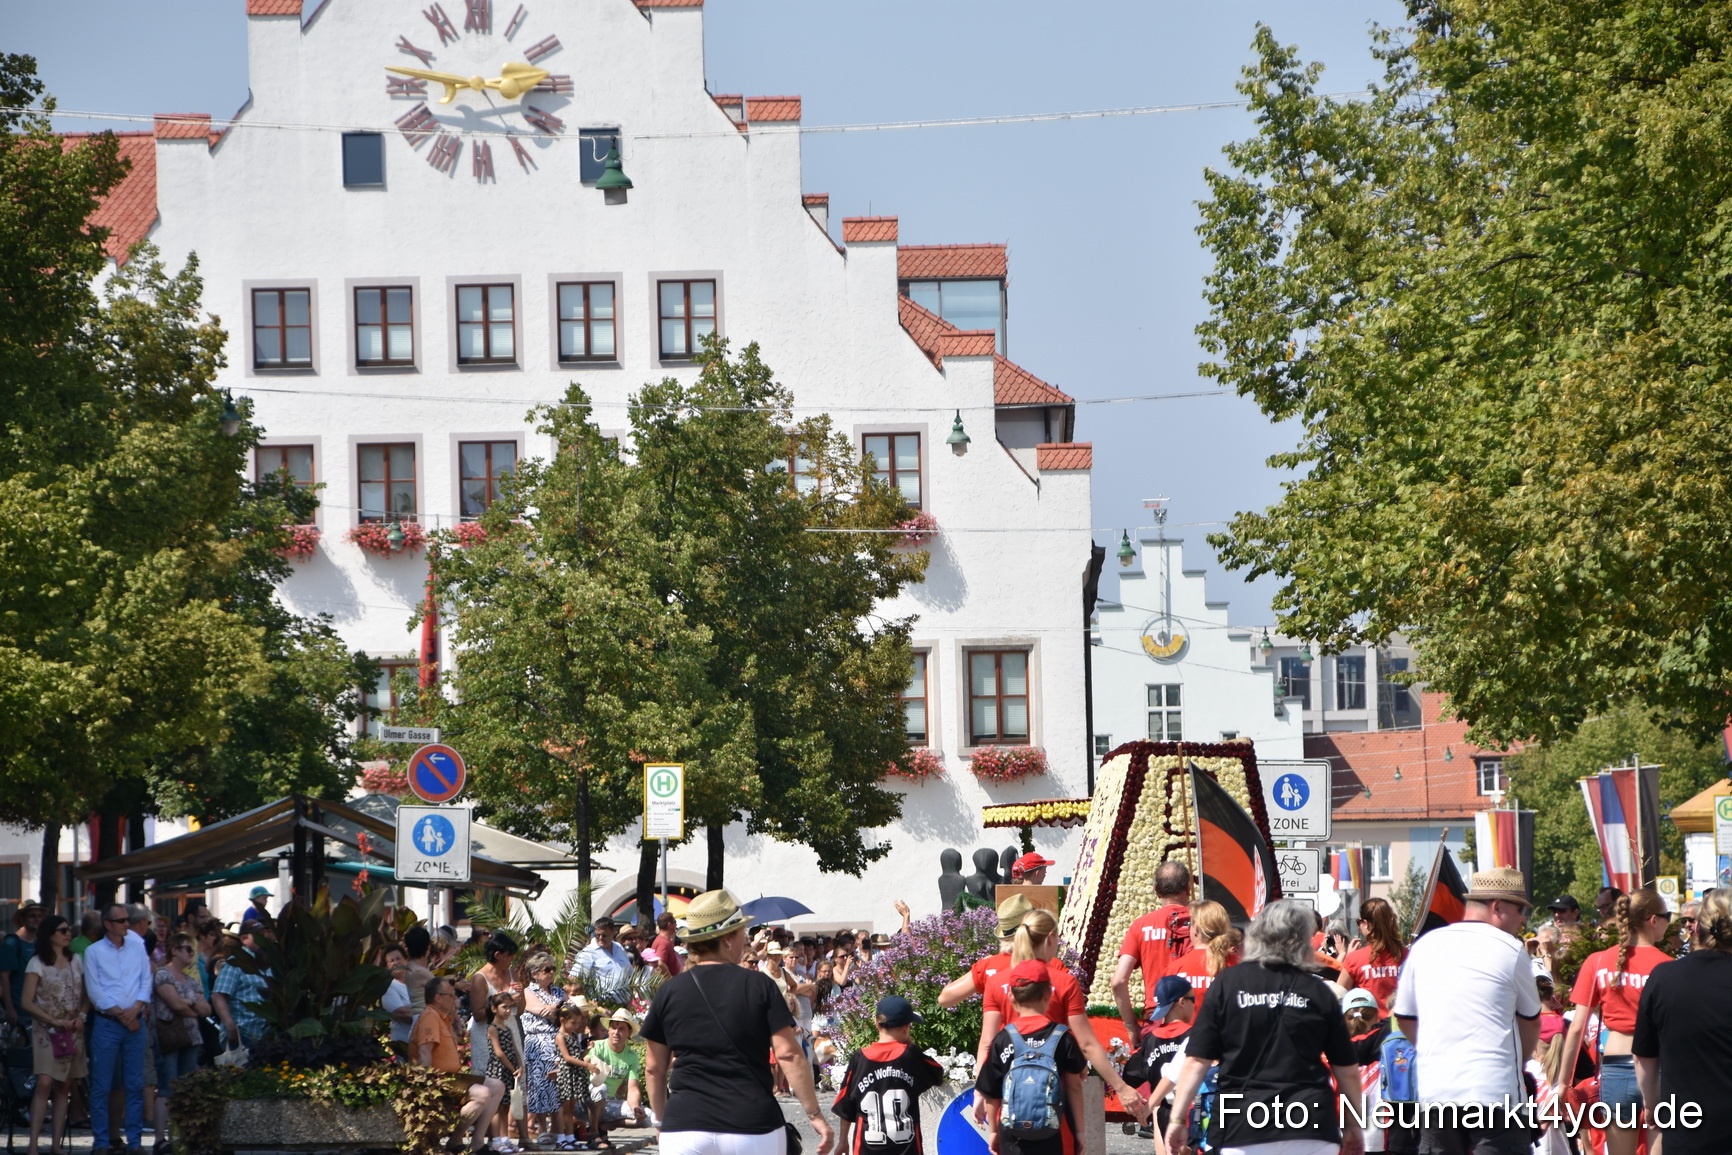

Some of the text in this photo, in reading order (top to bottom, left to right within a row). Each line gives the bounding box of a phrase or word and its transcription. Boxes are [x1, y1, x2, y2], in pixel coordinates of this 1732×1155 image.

[383, 729, 431, 740] Ulmer Gasse
[1273, 818, 1309, 830] ZONE
[1282, 878, 1300, 887] frei
[1237, 990, 1310, 1008] Übungsleiter
[1000, 1043, 1015, 1063] BSC
[858, 1066, 914, 1093] BSC Woffenbach
[860, 1089, 915, 1145] 10
